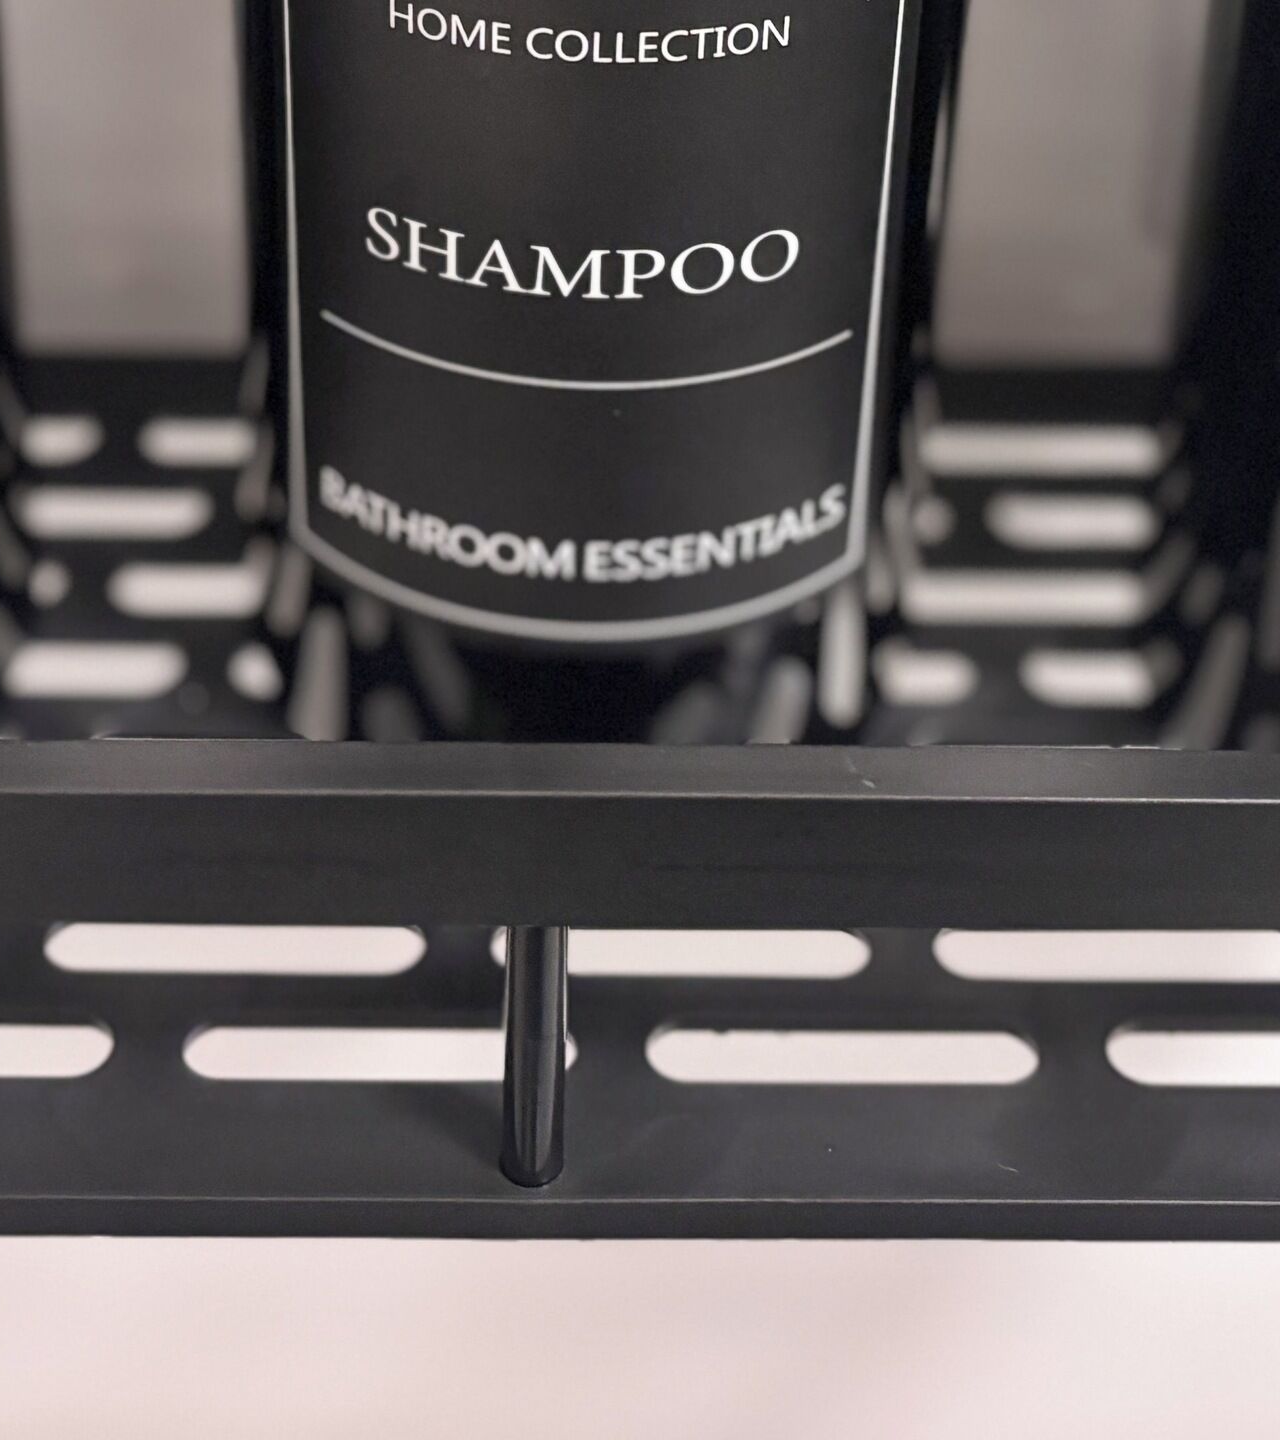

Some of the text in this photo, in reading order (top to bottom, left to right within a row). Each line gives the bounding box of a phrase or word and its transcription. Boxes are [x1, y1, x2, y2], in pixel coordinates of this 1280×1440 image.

[524, 15, 792, 64] COLLECTION
[364, 206, 801, 300] SHAMPOO
[319, 464, 849, 583] BATHROOM ESSENTIALS
